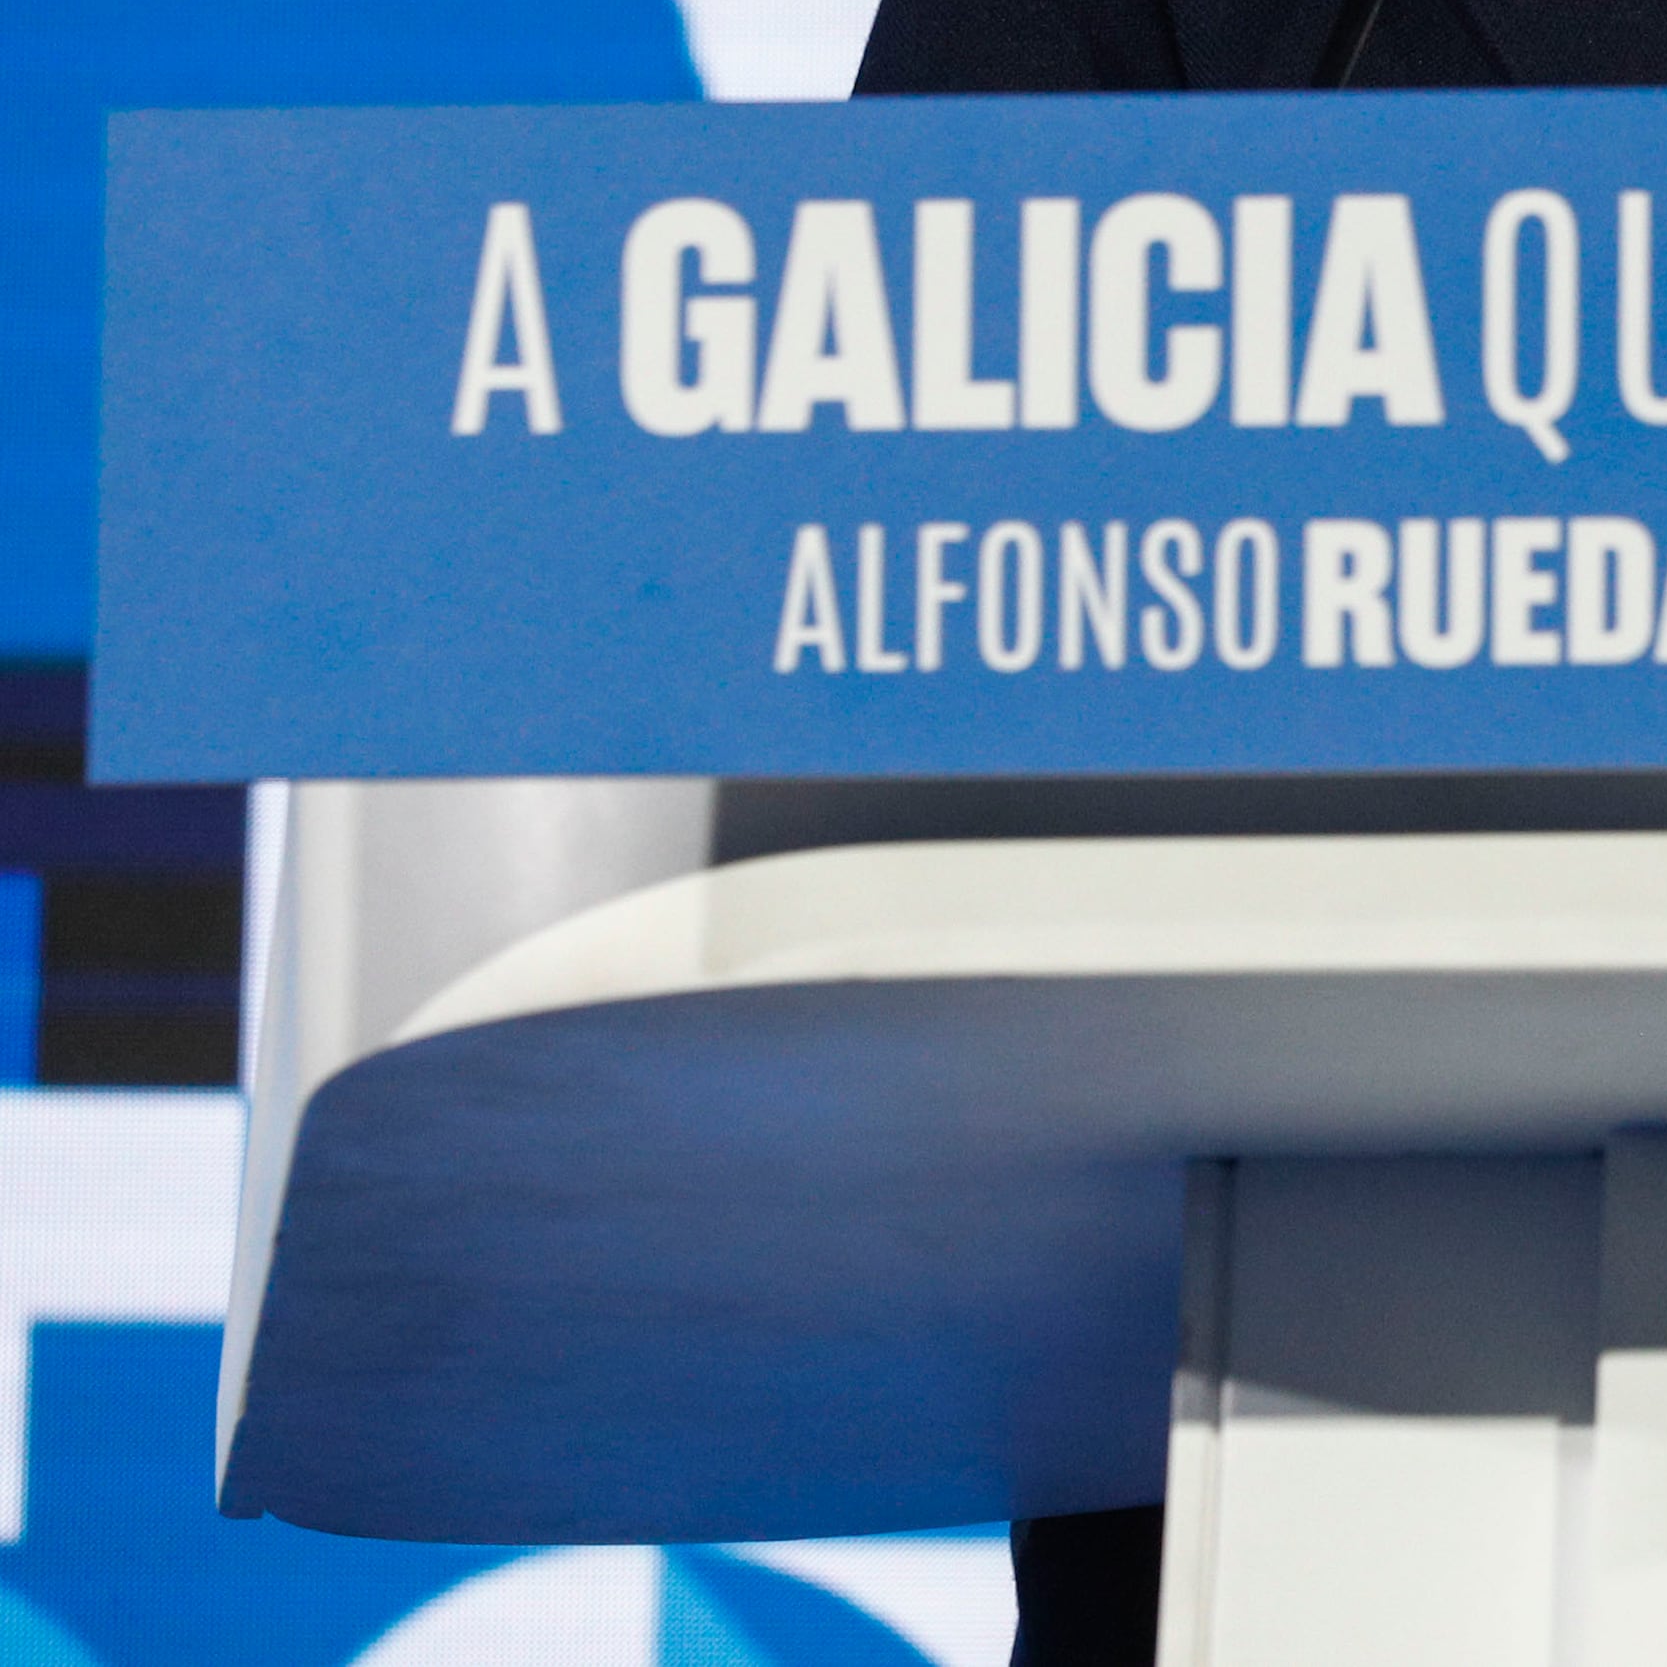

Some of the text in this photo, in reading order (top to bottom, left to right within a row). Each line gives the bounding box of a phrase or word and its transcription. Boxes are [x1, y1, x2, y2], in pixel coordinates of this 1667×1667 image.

[451, 201, 563, 437] A
[619, 191, 1446, 438] GALICIA
[773, 516, 1281, 675] ALFONSO
